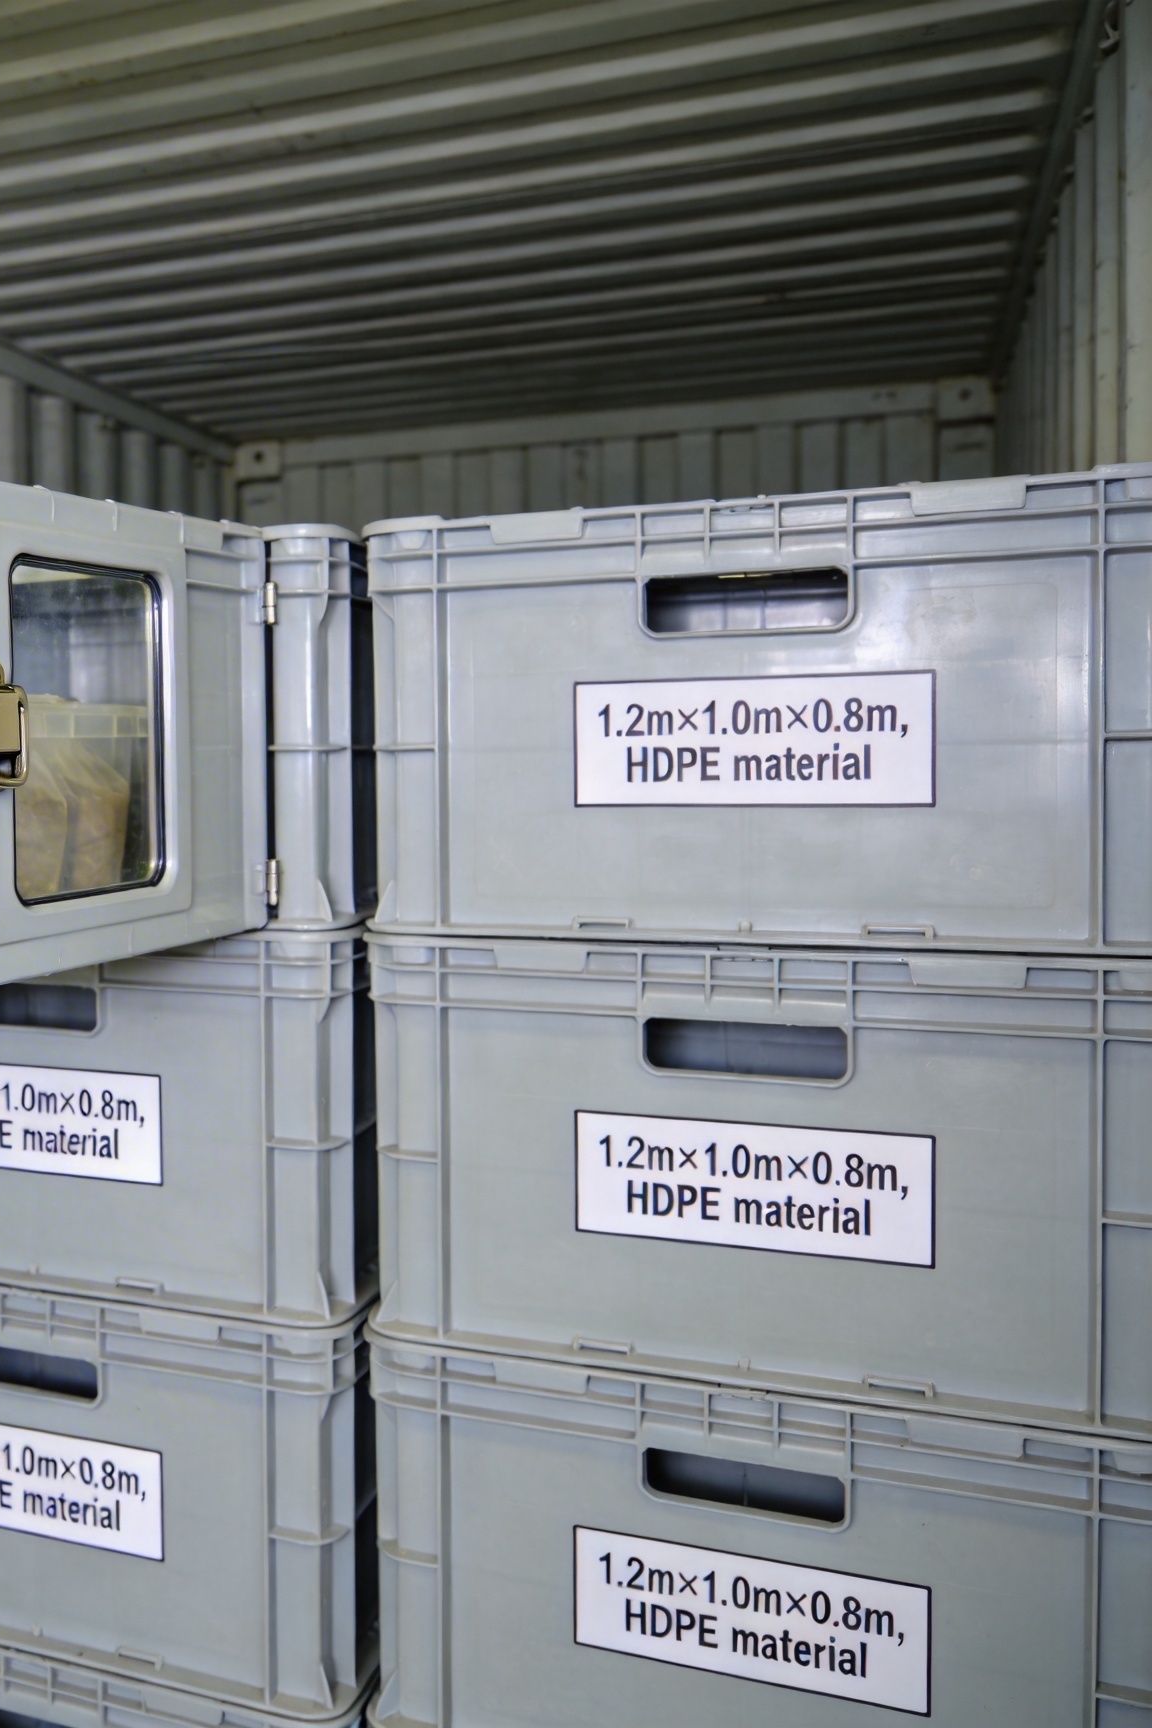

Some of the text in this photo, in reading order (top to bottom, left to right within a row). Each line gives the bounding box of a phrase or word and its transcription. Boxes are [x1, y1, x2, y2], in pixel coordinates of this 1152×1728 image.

[626, 742, 872, 783] HDPE material
[23, 1125, 119, 1159] material
[626, 1179, 872, 1236] HDPE material
[23, 1489, 121, 1532] material
[625, 1598, 867, 1679] HDPE material
